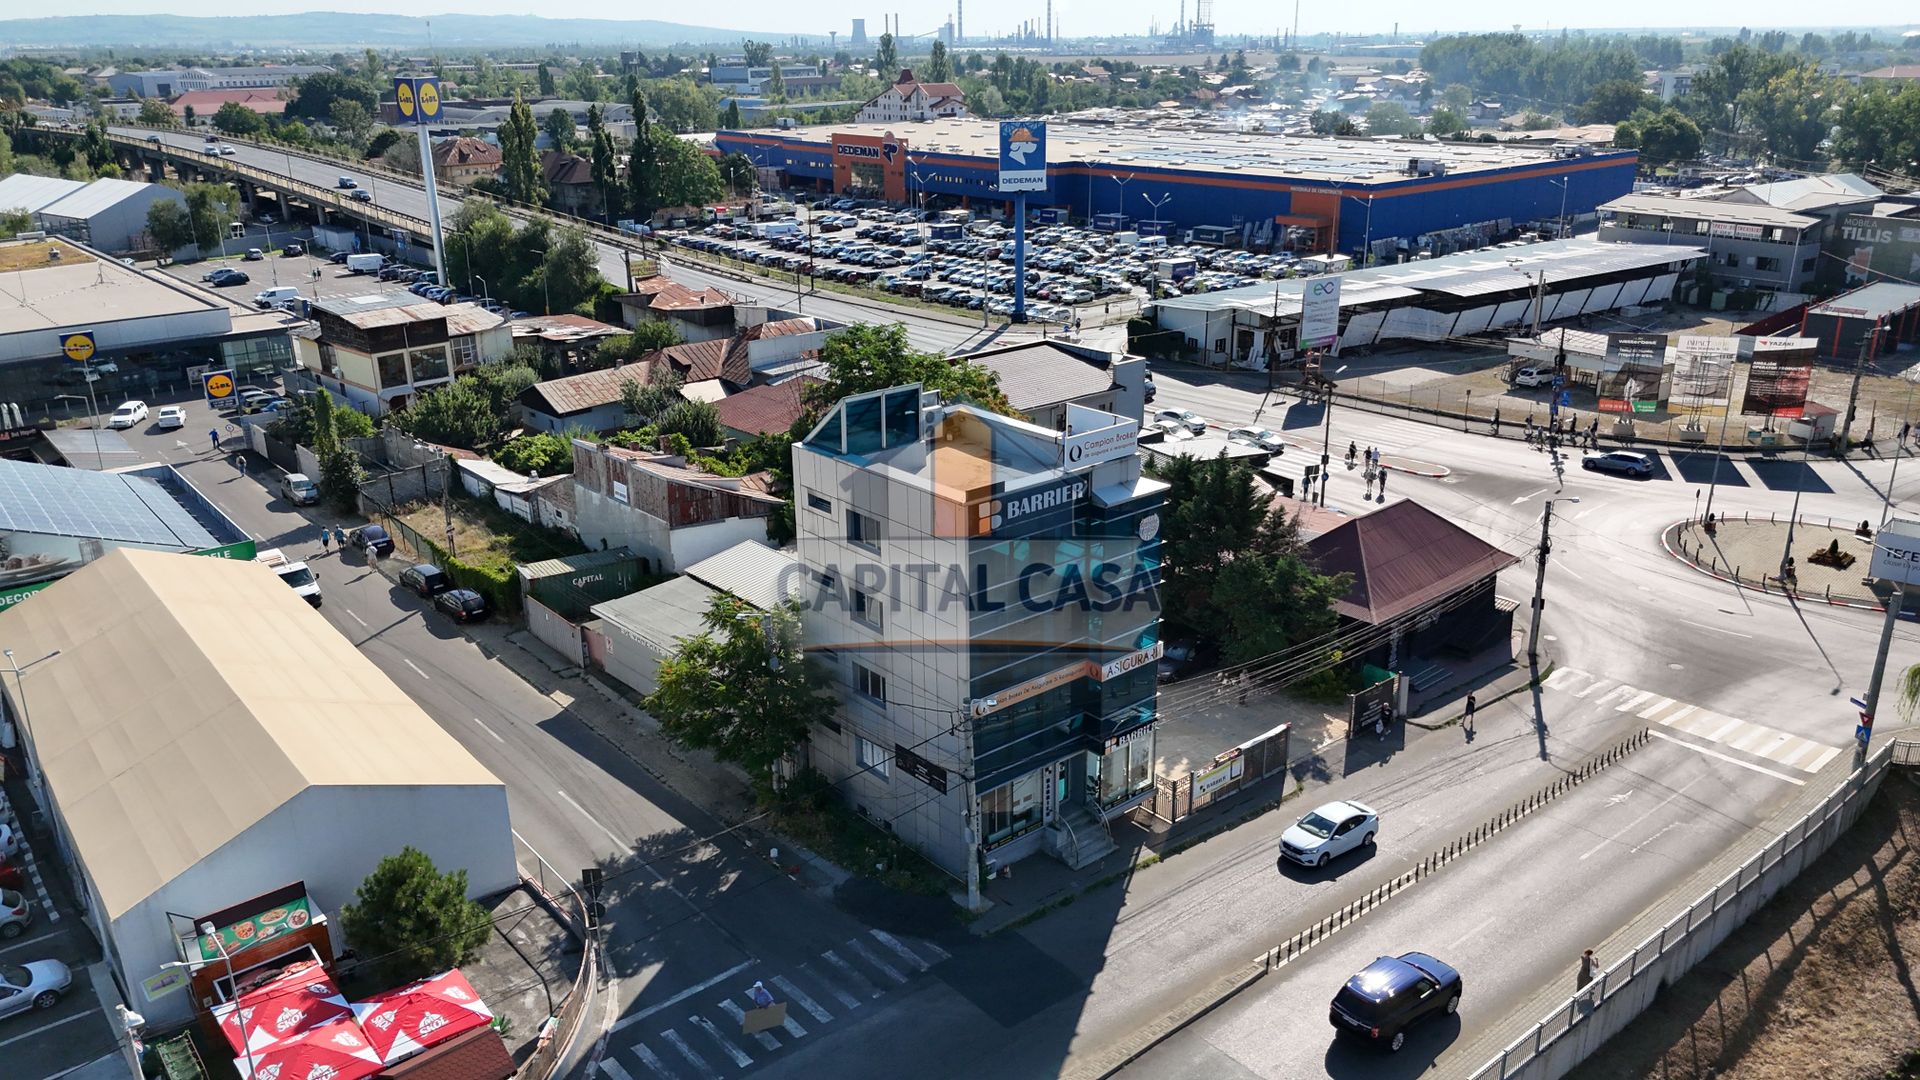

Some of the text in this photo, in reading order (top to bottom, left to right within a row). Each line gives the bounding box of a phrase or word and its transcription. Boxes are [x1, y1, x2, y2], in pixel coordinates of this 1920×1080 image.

[837, 144, 881, 158] DEDEMAN
[1844, 218, 1877, 228] MOBILA
[1841, 226, 1893, 243] TILLIS
[1115, 431, 1136, 442] Broker
[1007, 482, 1084, 519] BARRIER
[572, 574, 603, 585] CAPITAL
[1119, 722, 1157, 744] BARRIER
[276, 1012, 307, 1033] SKOL
[419, 1016, 449, 1038] SKOL
